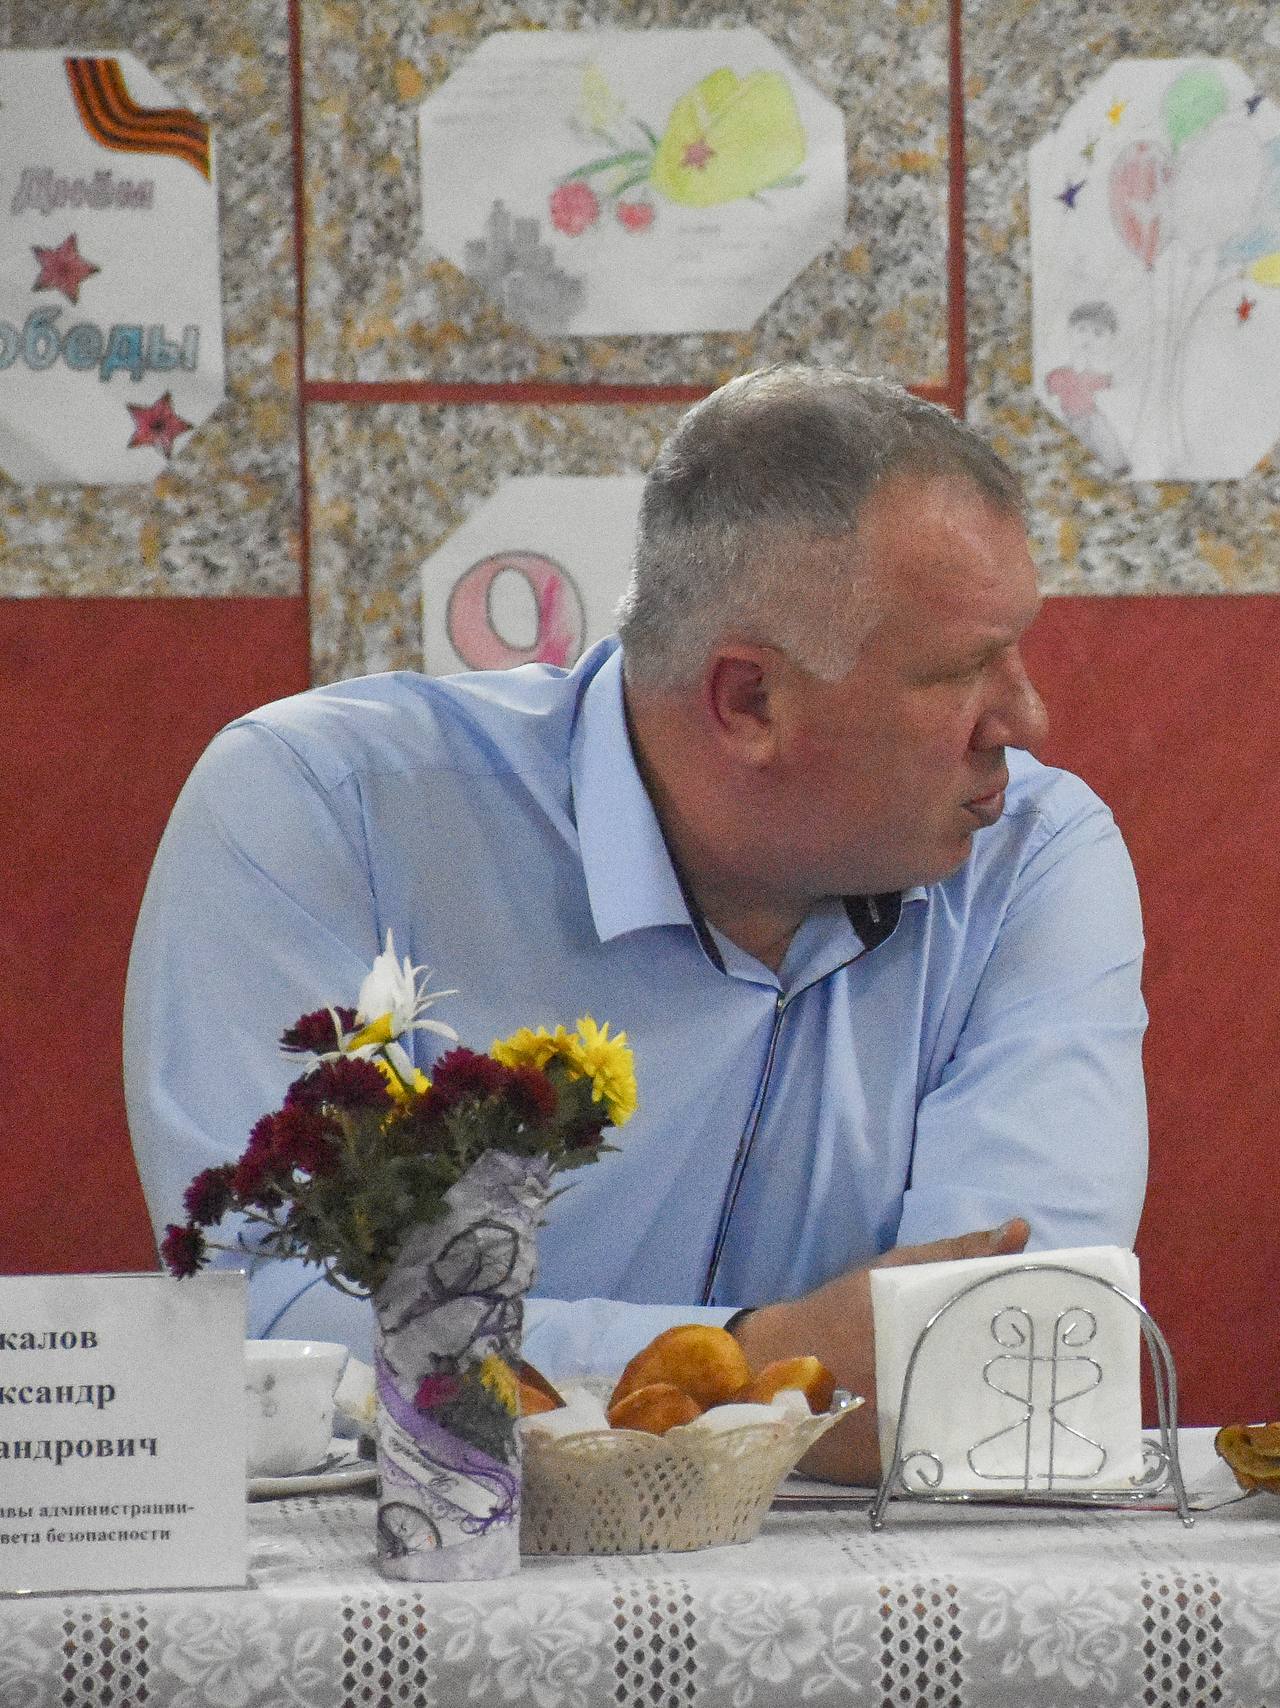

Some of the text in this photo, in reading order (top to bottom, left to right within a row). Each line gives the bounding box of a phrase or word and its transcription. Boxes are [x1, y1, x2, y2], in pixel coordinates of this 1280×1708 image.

[0, 1330, 98, 1350] калов
[0, 1384, 116, 1410] ксандр
[0, 1437, 158, 1466] андрович
[46, 1527, 171, 1543] безопасности
